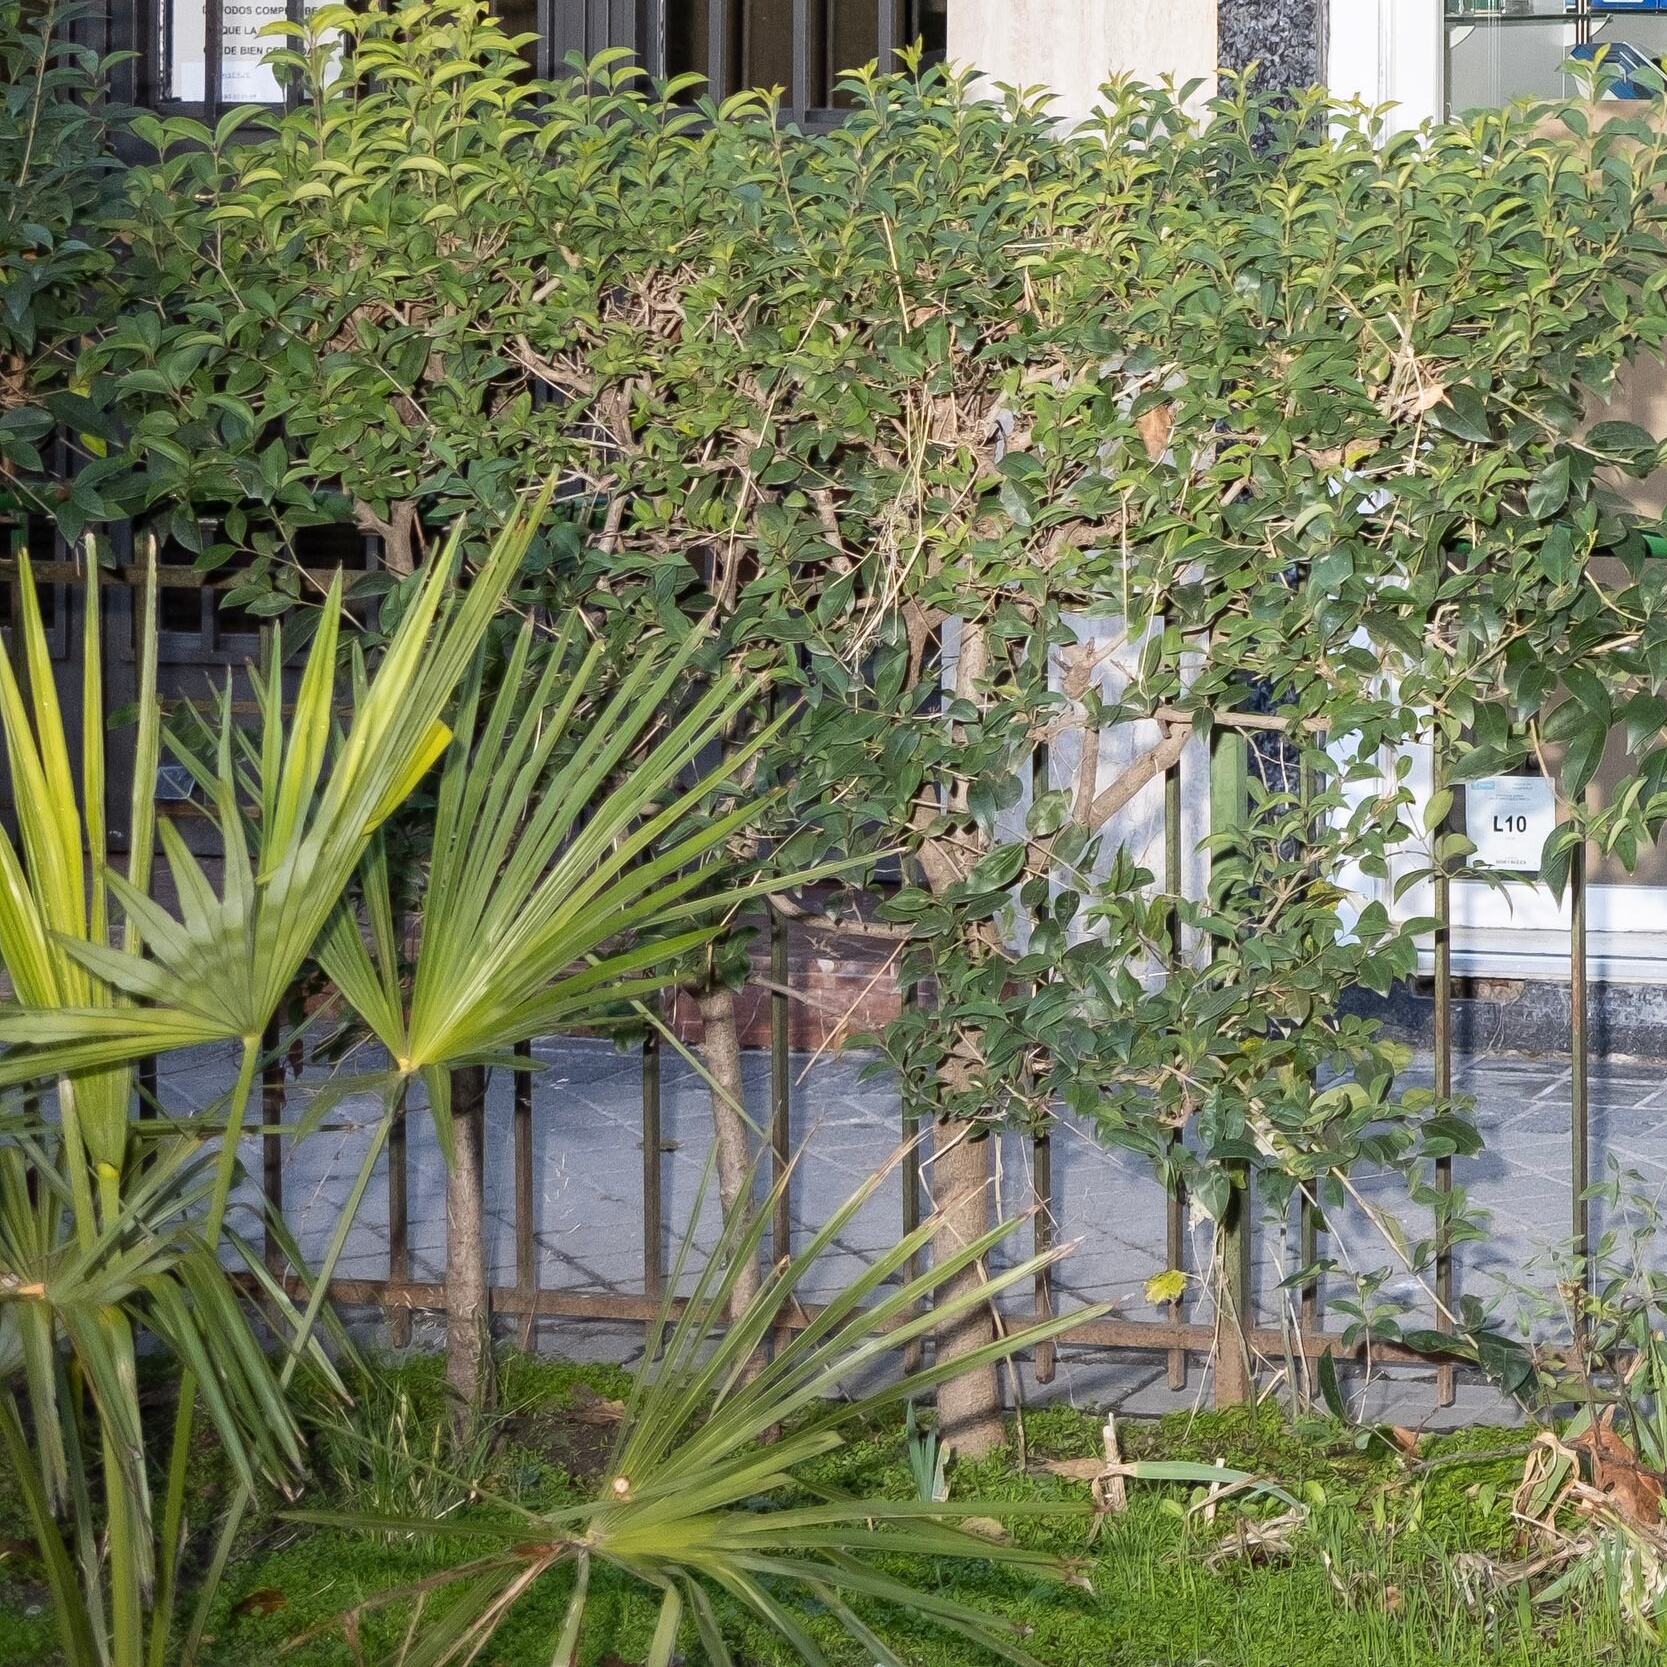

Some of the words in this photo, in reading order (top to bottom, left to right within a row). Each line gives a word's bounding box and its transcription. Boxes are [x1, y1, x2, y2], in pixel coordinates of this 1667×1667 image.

[224, 6, 252, 15] ODOS
[244, 26, 257, 34] LA
[240, 46, 263, 55] BIEN
[1493, 815, 1527, 833] L10
